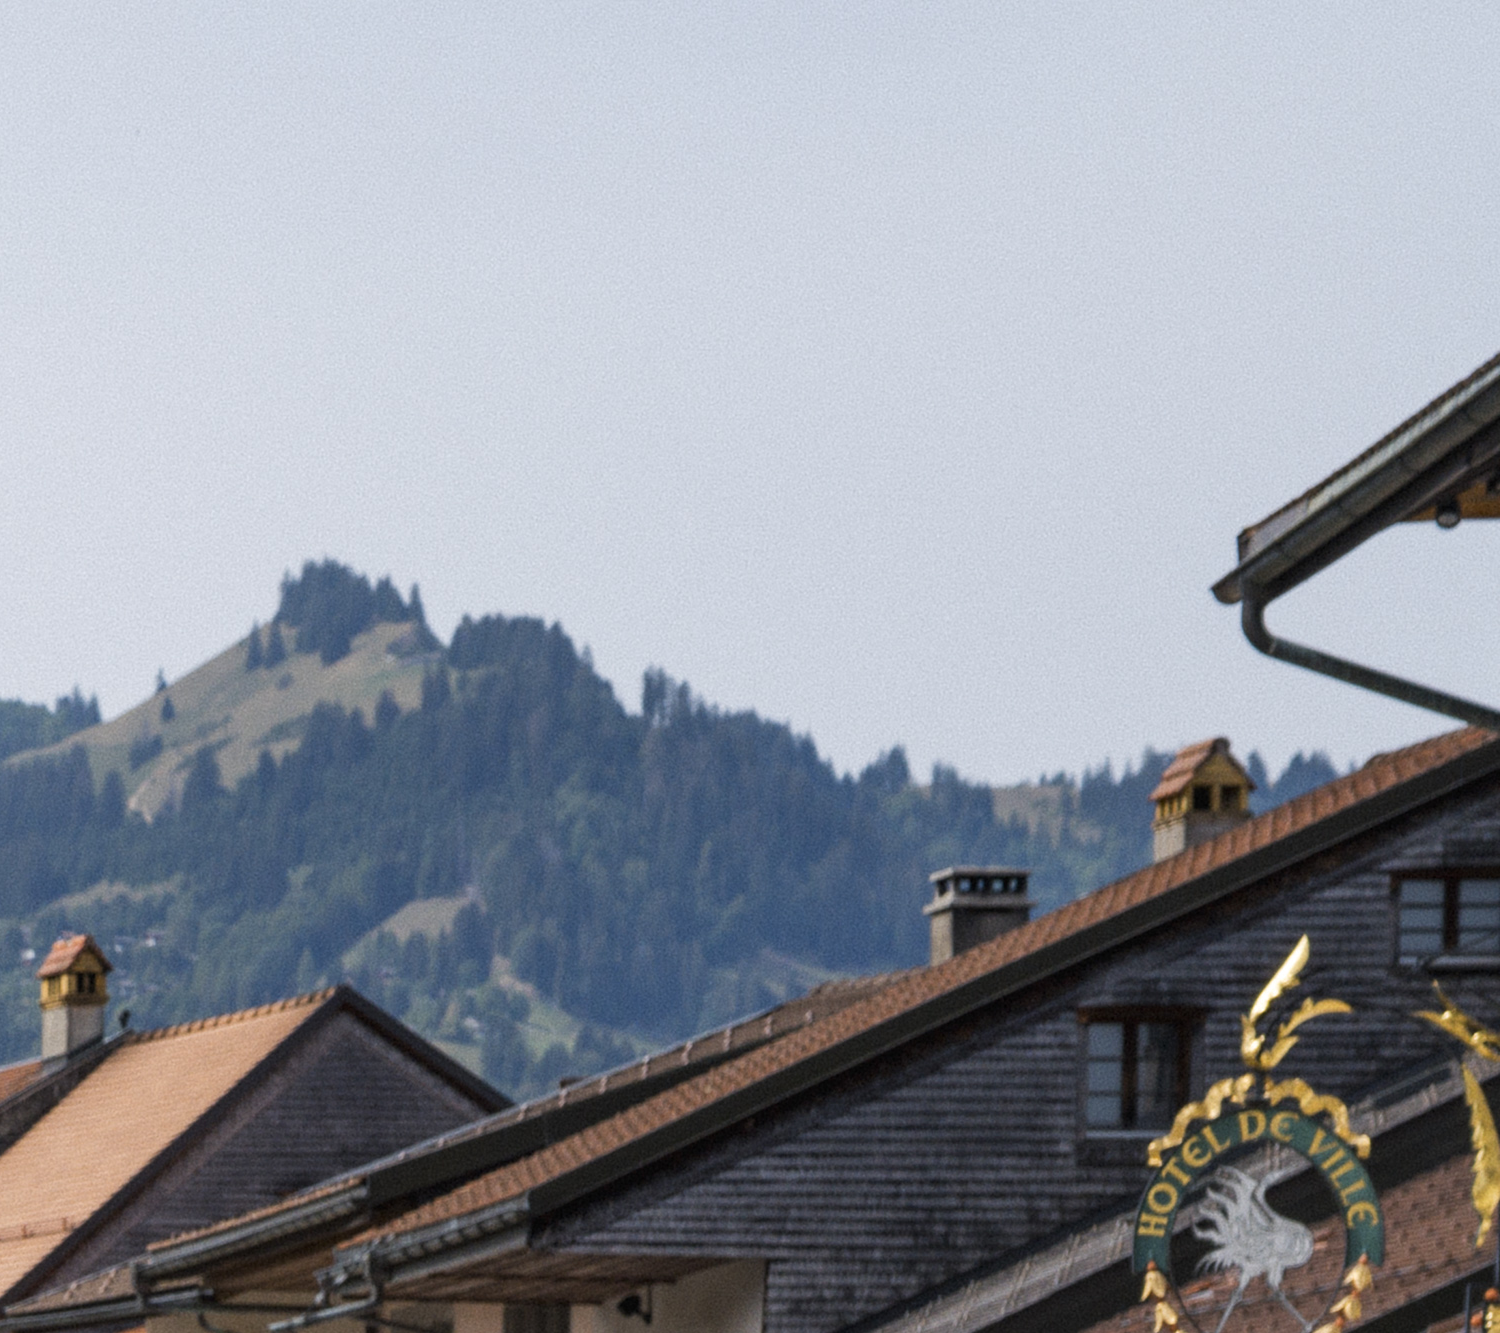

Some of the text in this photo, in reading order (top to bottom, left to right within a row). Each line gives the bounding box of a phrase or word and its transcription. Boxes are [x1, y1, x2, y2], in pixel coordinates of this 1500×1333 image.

[1137, 1109, 1380, 1238] HOTEL DE VILLE
